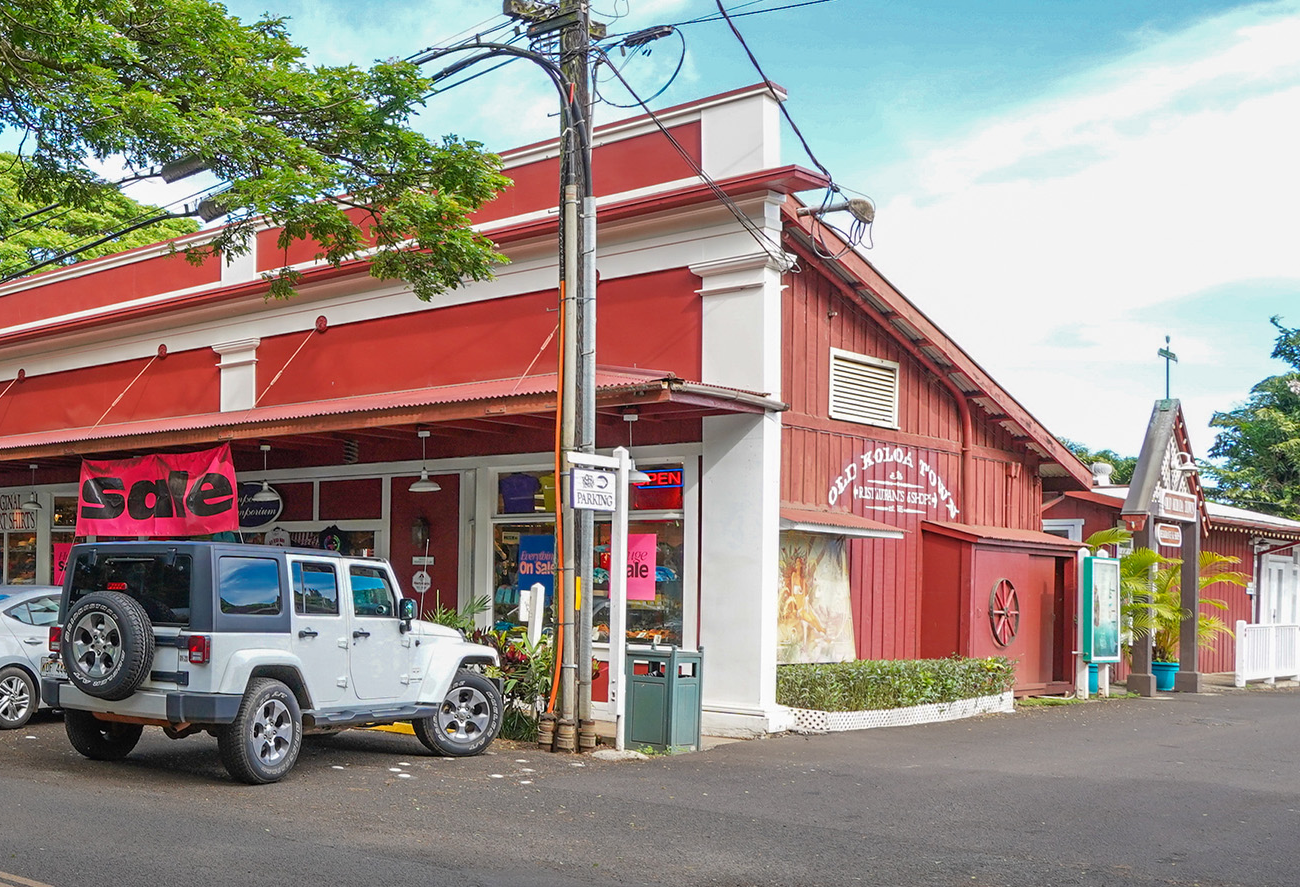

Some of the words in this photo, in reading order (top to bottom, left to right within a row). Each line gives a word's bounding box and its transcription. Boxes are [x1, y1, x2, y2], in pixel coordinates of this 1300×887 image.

[828, 463, 857, 505] OLD
[860, 447, 914, 470] KOLOA
[919, 459, 960, 519] TOWN
[577, 492, 613, 507] PARKING
[238, 507, 277, 517] mporium
[8, 512, 36, 530] SHIRTS
[521, 551, 555, 562] Everythin
[628, 551, 648, 564] uge
[520, 561, 534, 575] On
[627, 561, 649, 578] ale
